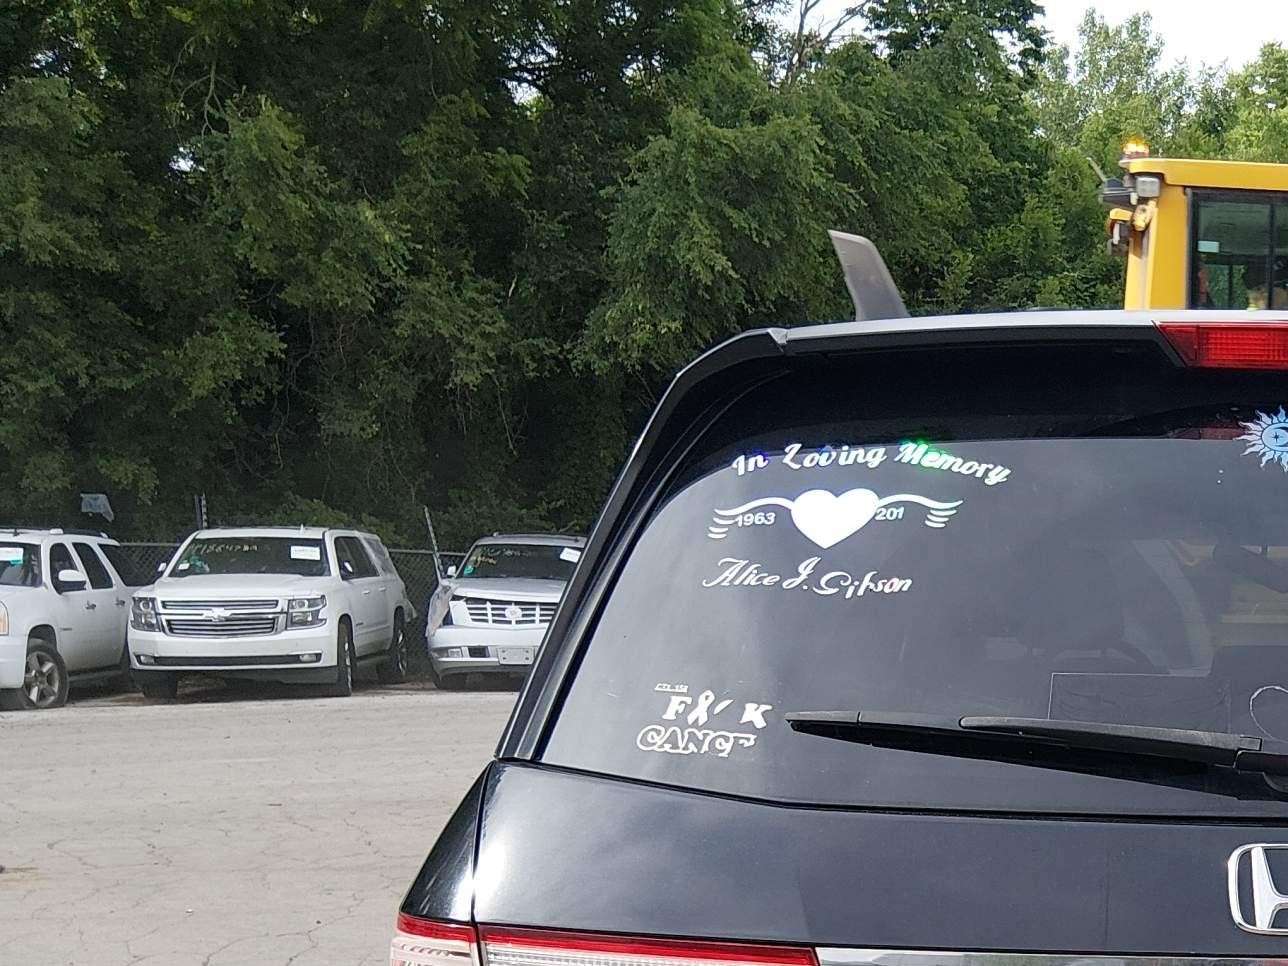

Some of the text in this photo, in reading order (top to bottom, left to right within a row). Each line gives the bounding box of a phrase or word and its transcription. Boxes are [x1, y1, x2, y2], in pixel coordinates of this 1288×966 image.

[731, 443, 1012, 486] In Loving Memory
[736, 511, 777, 528] 1963
[702, 556, 781, 588] Alice
